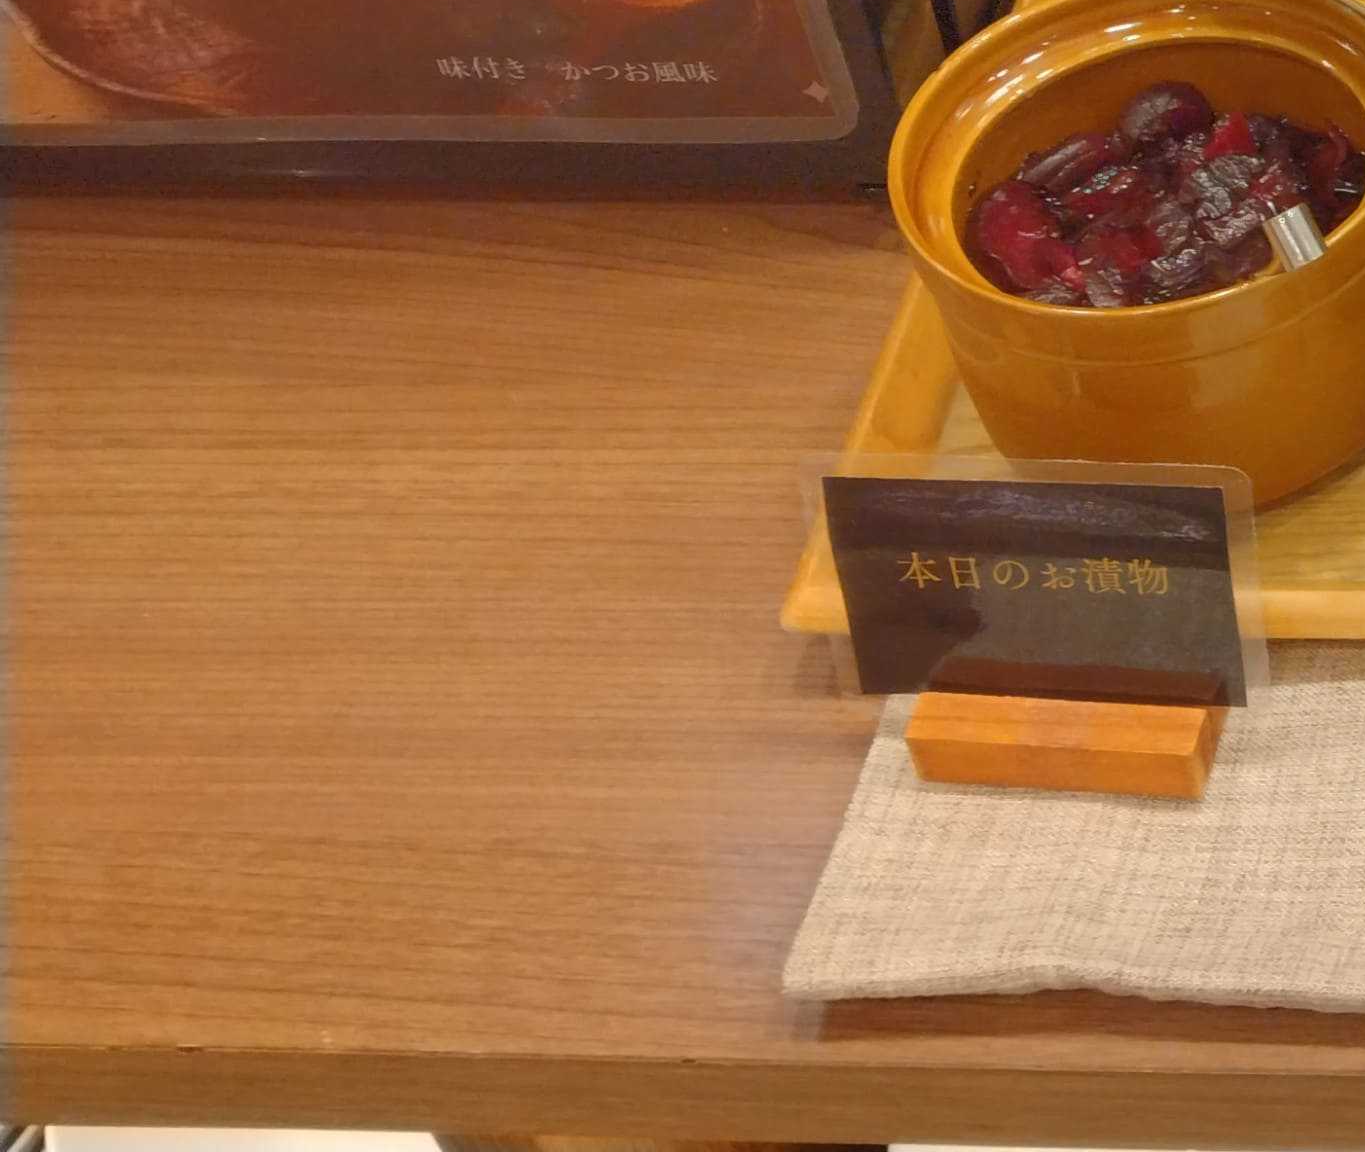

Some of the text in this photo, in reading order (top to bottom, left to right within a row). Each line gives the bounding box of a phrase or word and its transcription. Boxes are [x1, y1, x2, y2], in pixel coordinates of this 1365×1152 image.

[435, 56, 719, 84] 味付き かつお風味
[898, 551, 1169, 596] 本日のお漬物
